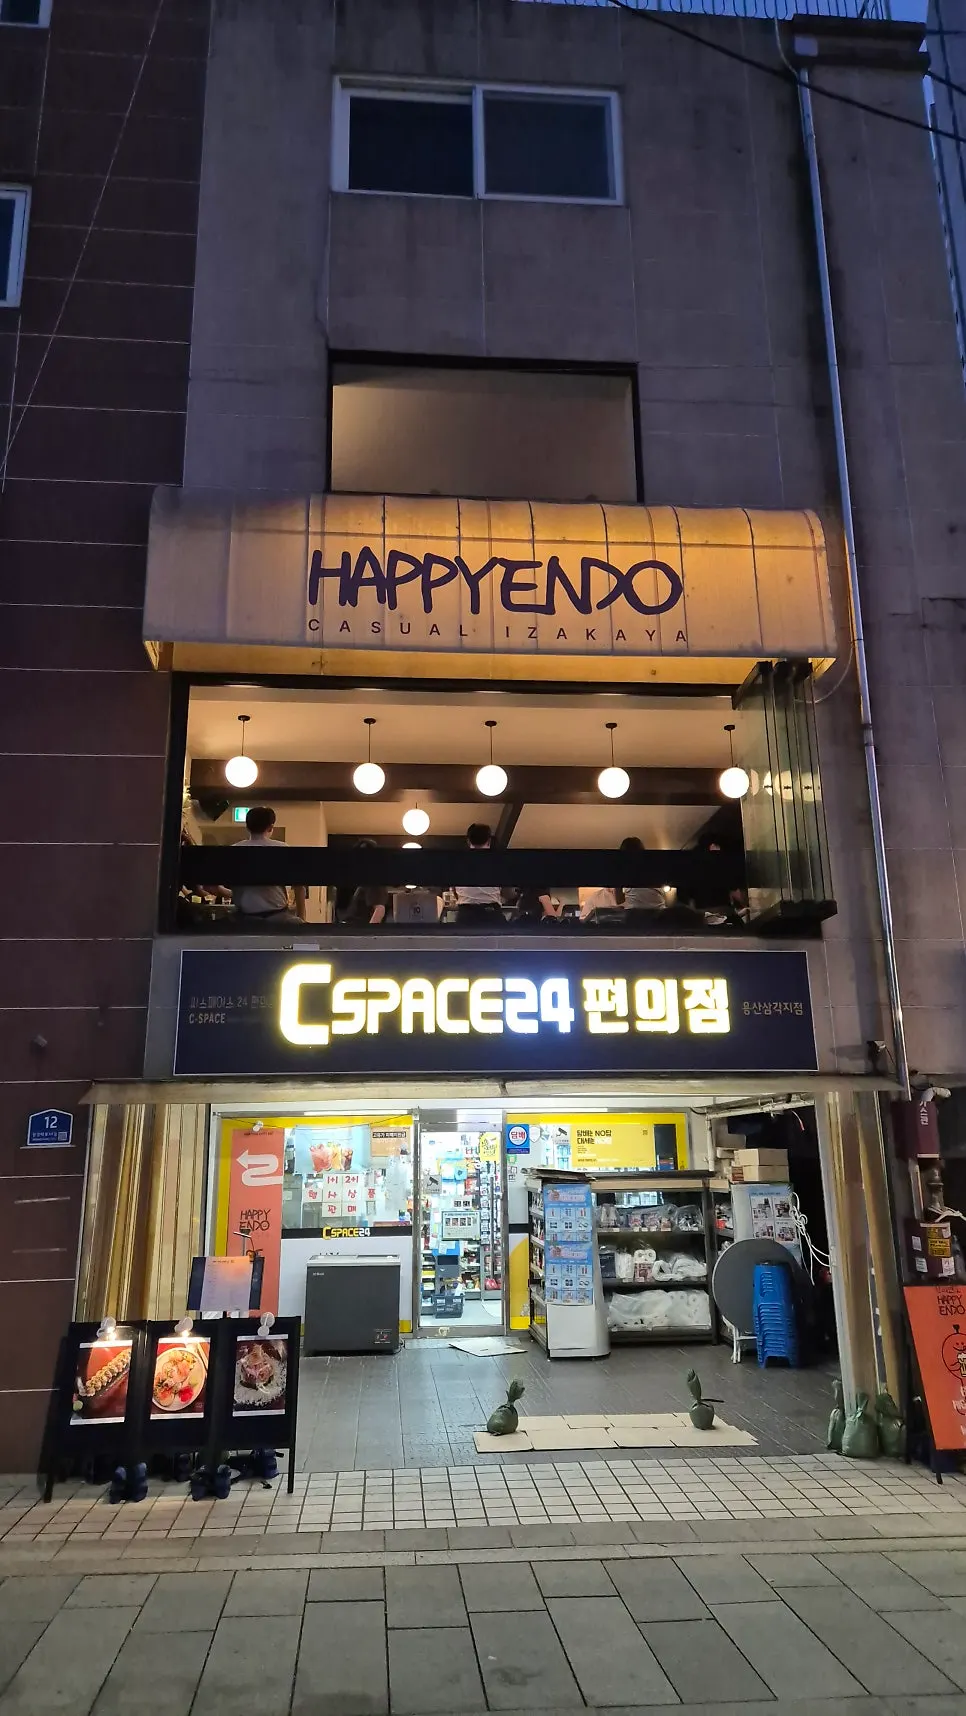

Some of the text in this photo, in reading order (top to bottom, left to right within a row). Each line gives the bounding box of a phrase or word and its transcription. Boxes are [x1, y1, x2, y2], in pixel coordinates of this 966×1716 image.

[308, 618, 687, 642] CASUAL IZAKAYA
[582, 978, 731, 1034] 편의점
[742, 1001, 804, 1016] 용산삼각지점
[189, 1013, 226, 1024] C-SPACE
[44, 1115, 58, 1129] 12
[510, 1131, 526, 1140] 담배
[327, 1175, 359, 1184] 1+1 2+1
[240, 1208, 272, 1221] HAPPY
[322, 1226, 371, 1240] CSPACE24
[937, 1295, 963, 1306] HAPPY
[940, 1304, 966, 1316] ENDO
